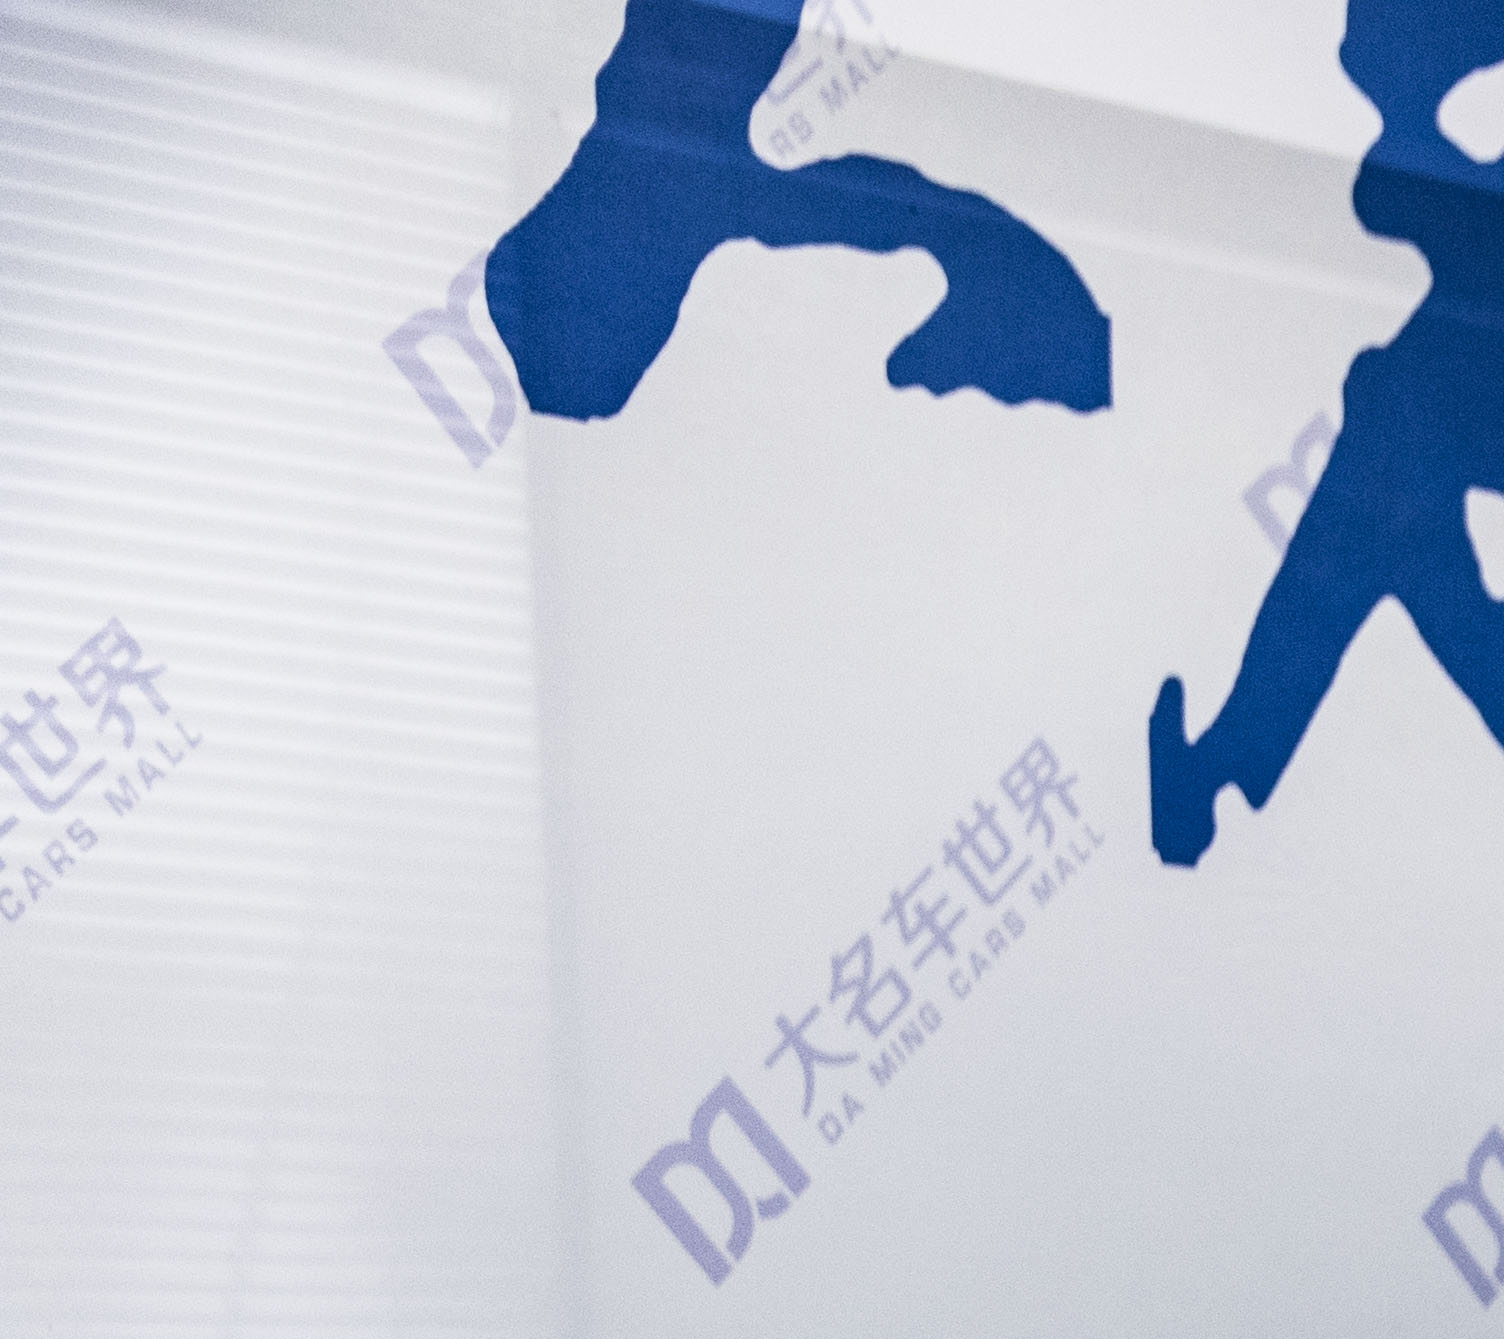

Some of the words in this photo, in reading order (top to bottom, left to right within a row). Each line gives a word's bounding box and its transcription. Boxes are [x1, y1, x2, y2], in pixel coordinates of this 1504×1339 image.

[0, 819, 98, 921] CARS
[104, 720, 203, 817] MALL
[765, 735, 1079, 1118] 大名车世界
[817, 1092, 864, 1146] DA
[868, 1001, 944, 1087] MING
[947, 909, 1027, 1000] CARS
[1029, 824, 1104, 906] MALL
